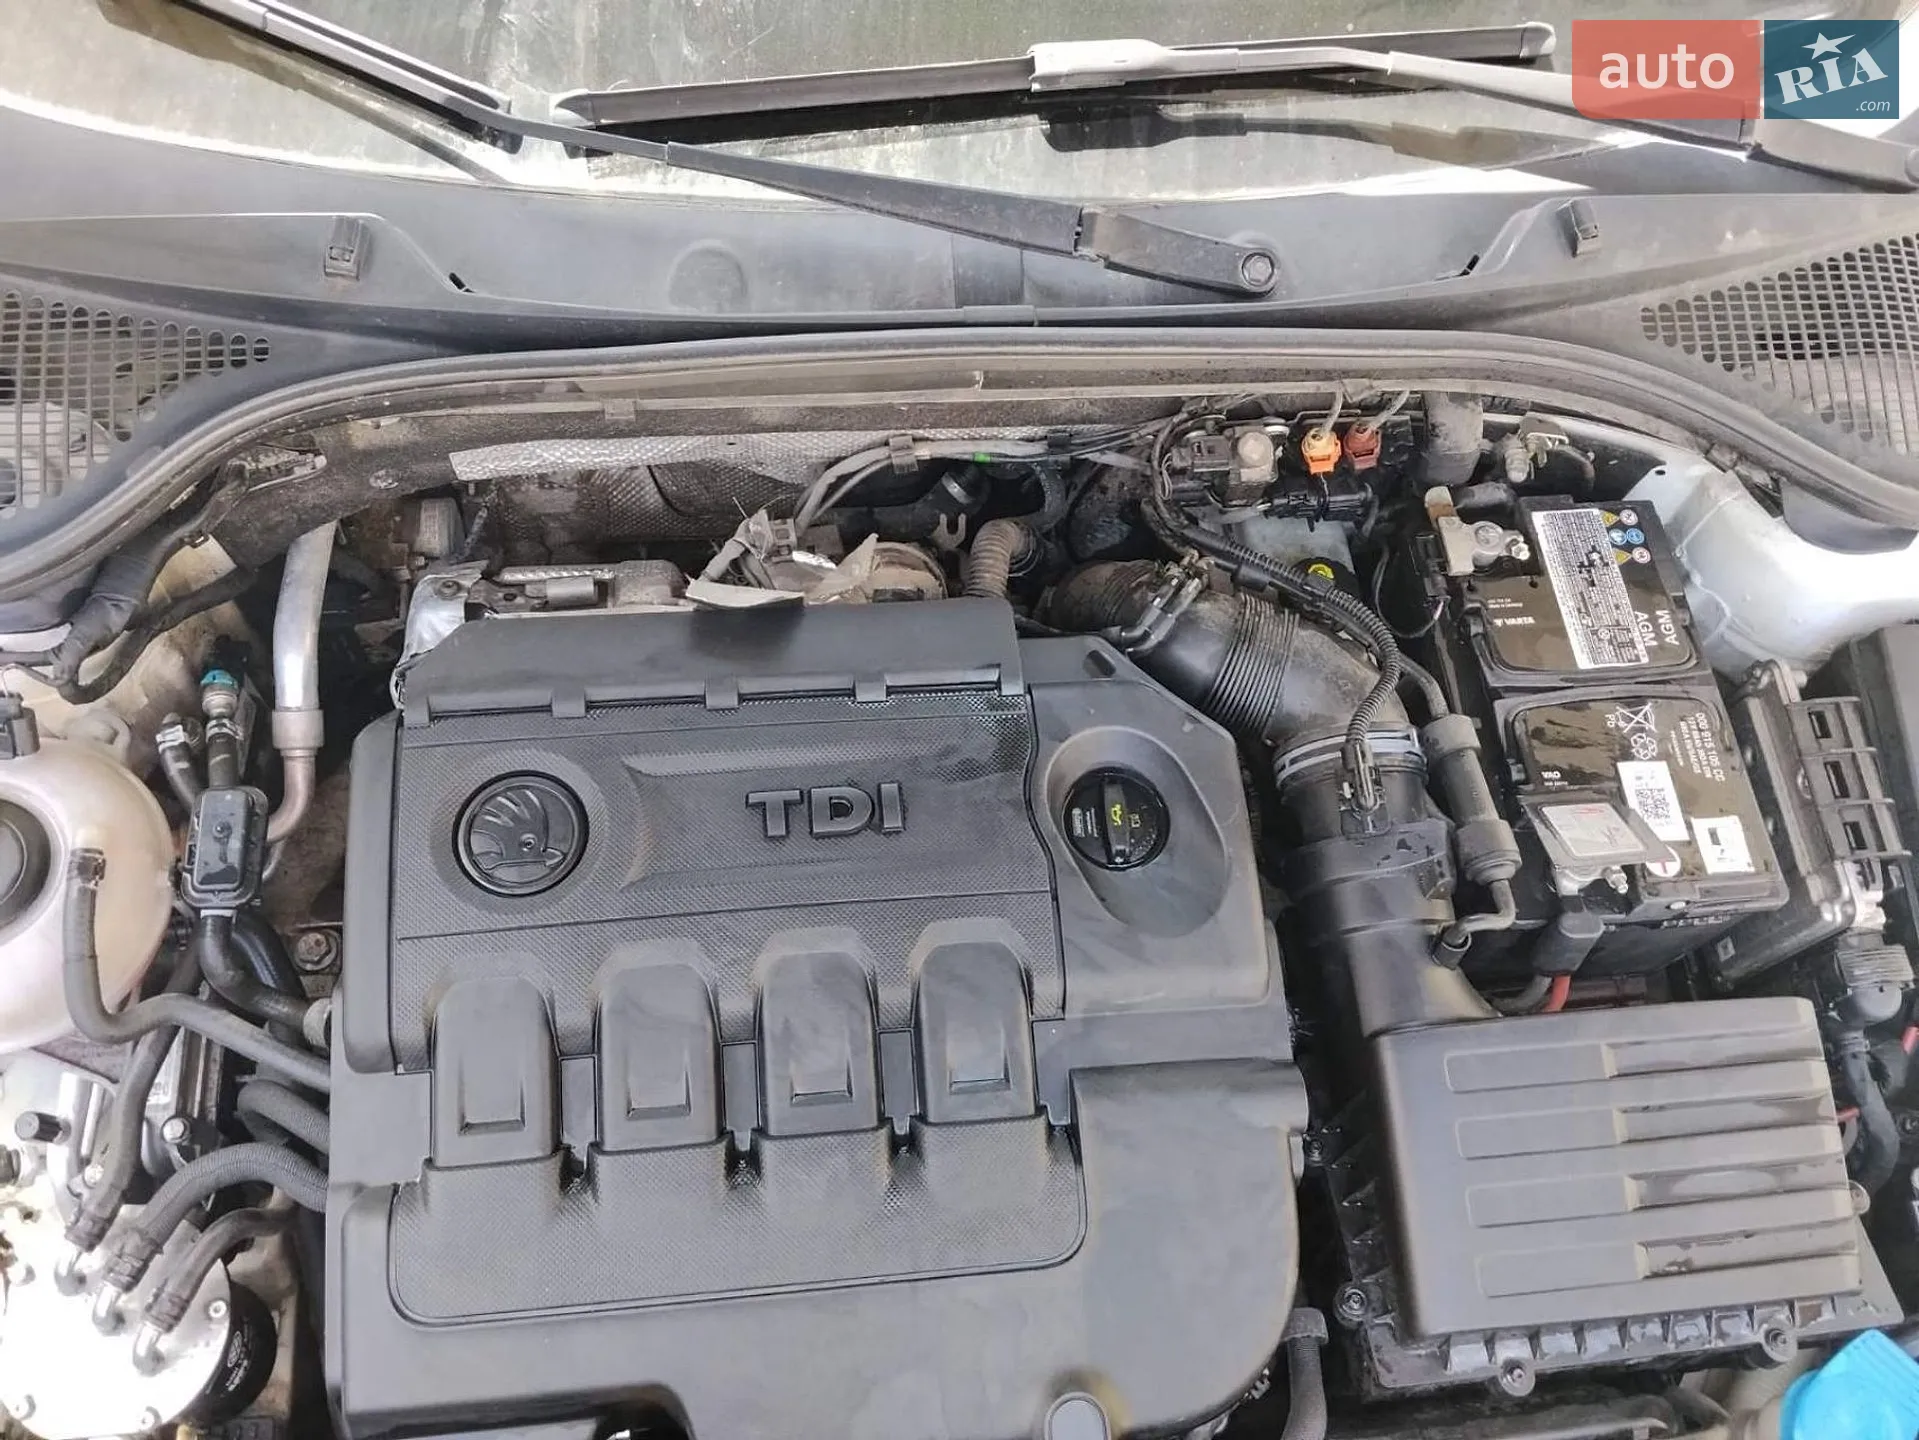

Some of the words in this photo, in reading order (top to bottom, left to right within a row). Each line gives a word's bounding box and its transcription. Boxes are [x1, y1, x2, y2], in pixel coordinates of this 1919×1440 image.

[1504, 616, 1535, 626] VARTA
[1634, 611, 1658, 646] AGM
[1655, 610, 1680, 646] AGM
[746, 781, 905, 838] TDI
